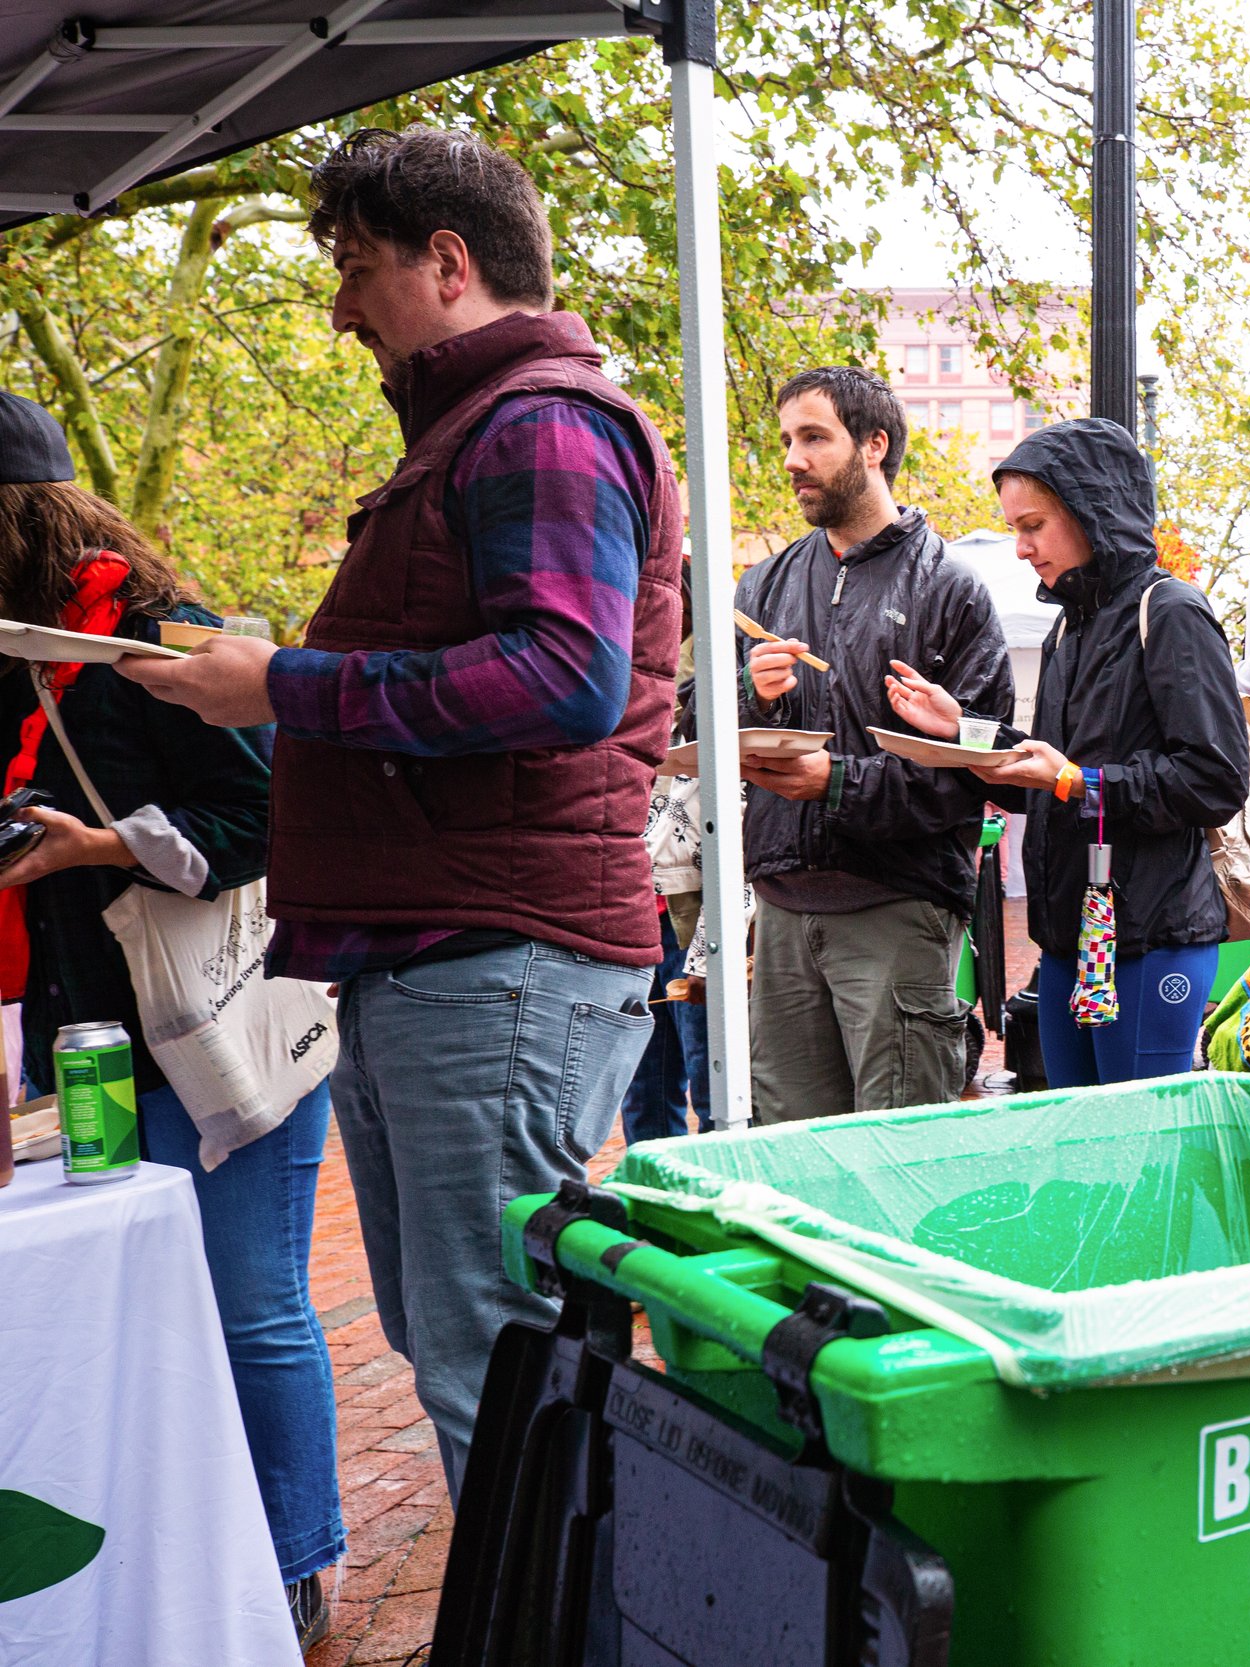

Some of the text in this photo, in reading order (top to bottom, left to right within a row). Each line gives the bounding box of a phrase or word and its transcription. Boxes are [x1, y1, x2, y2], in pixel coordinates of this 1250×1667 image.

[215, 980, 243, 1011] Saving
[240, 958, 263, 980] lives
[290, 1022, 327, 1063] ASPCA
[609, 1391, 655, 1436] CLOSE
